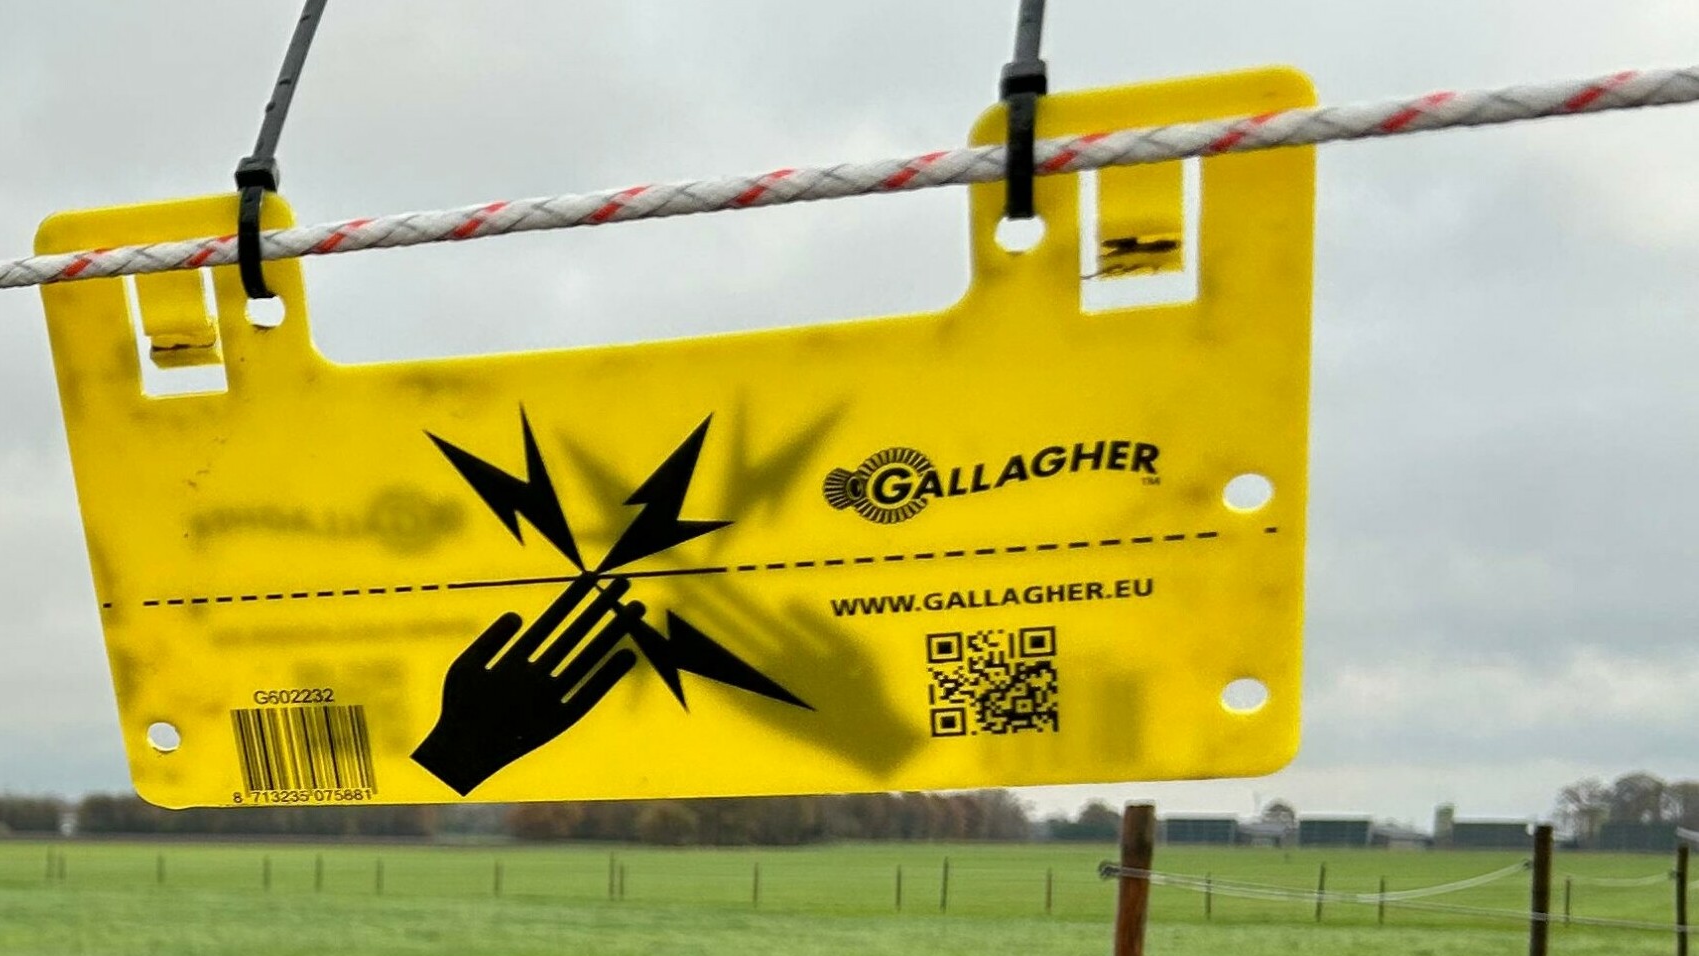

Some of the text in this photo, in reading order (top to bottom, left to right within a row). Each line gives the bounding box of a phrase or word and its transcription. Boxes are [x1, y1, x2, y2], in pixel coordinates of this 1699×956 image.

[871, 440, 1159, 505] GALLAGHER
[830, 578, 1154, 617] WWW.GALLAGHER.EU
[254, 688, 335, 705] G602232
[232, 791, 244, 804] 8
